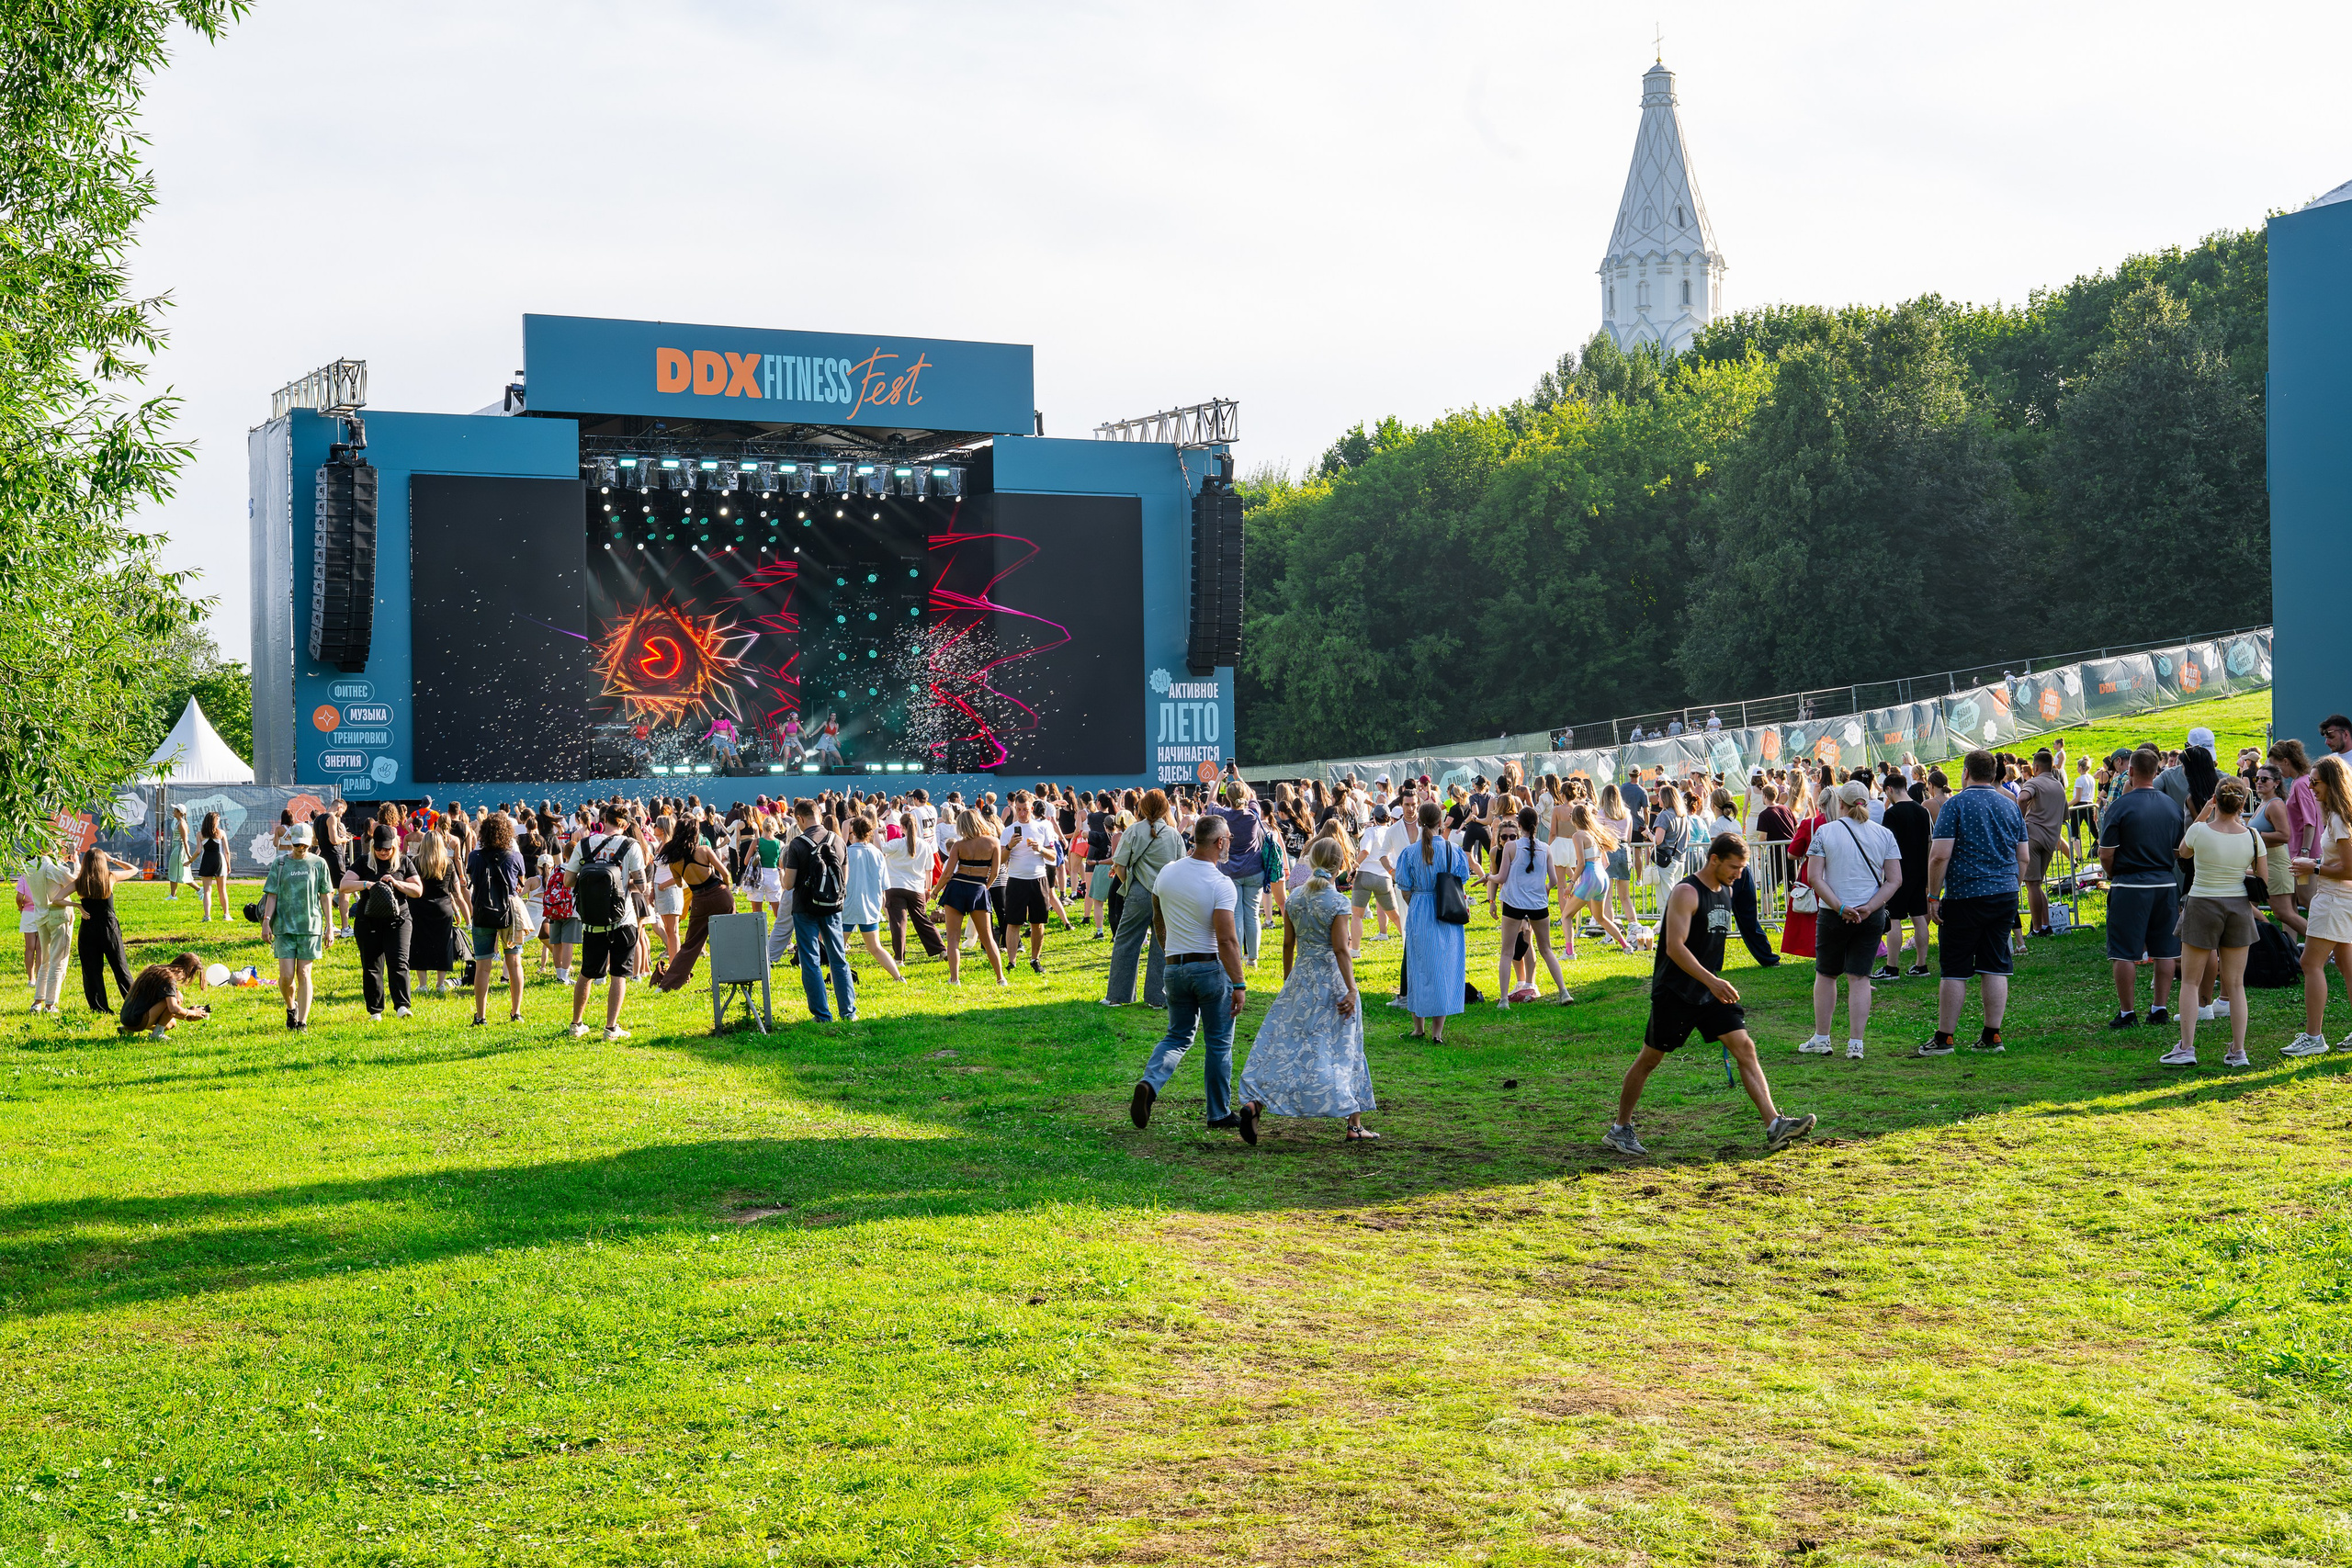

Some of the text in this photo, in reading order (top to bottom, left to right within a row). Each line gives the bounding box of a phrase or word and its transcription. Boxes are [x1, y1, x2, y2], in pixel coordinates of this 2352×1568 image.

[656, 347, 933, 421] DDX FITNESS Fest
[334, 685, 368, 698] ФИТНЕС
[1169, 682, 1219, 699] АКТИВНОЕ
[350, 708, 387, 721] МУЗЫКА
[1158, 702, 1219, 742] ЛЕТО
[334, 732, 387, 744] ТРЕНИРОВКИ
[325, 755, 362, 768] ЭНЕРГИЯ
[1158, 746, 1220, 762] НАЧИНАЕТСЯ
[1158, 765, 1193, 784] ЗДЕСЬ!
[343, 776, 371, 792] ДРАЙВ
[58, 814, 90, 835] БУДЕТ
